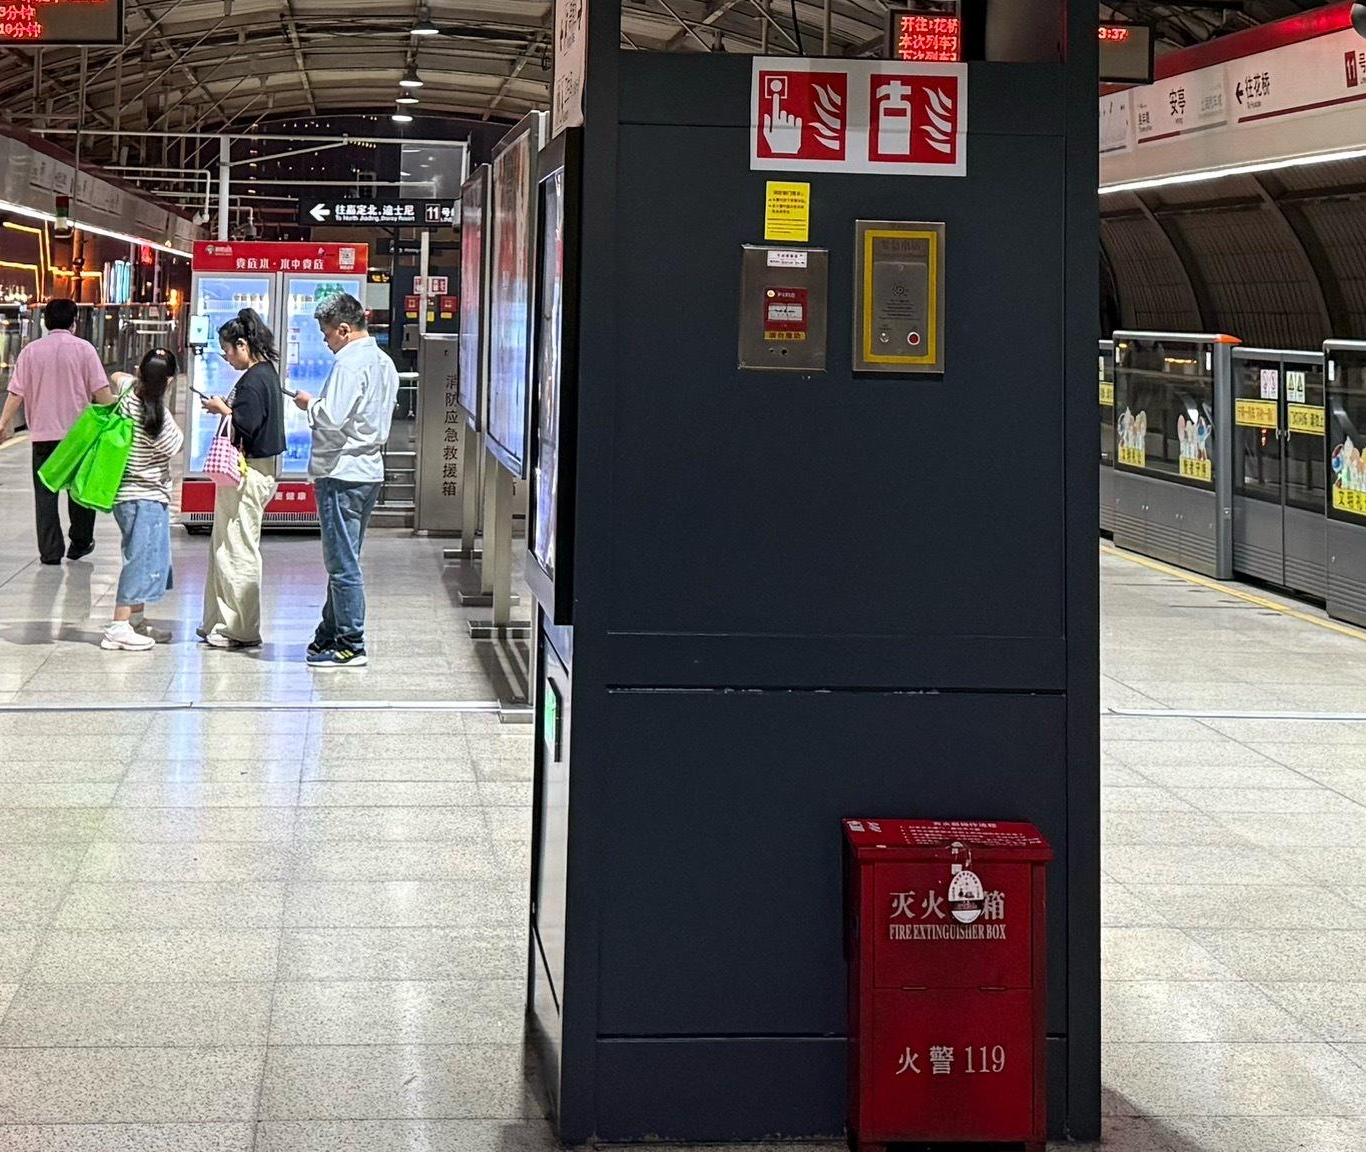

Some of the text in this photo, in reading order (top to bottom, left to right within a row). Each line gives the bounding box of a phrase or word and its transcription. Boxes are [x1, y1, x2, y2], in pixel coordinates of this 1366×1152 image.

[889, 890, 1006, 921] 灭火箱
[889, 924, 1007, 940] FIRE EXTINGUISHER BOX
[896, 1045, 1006, 1075] 火警 119
